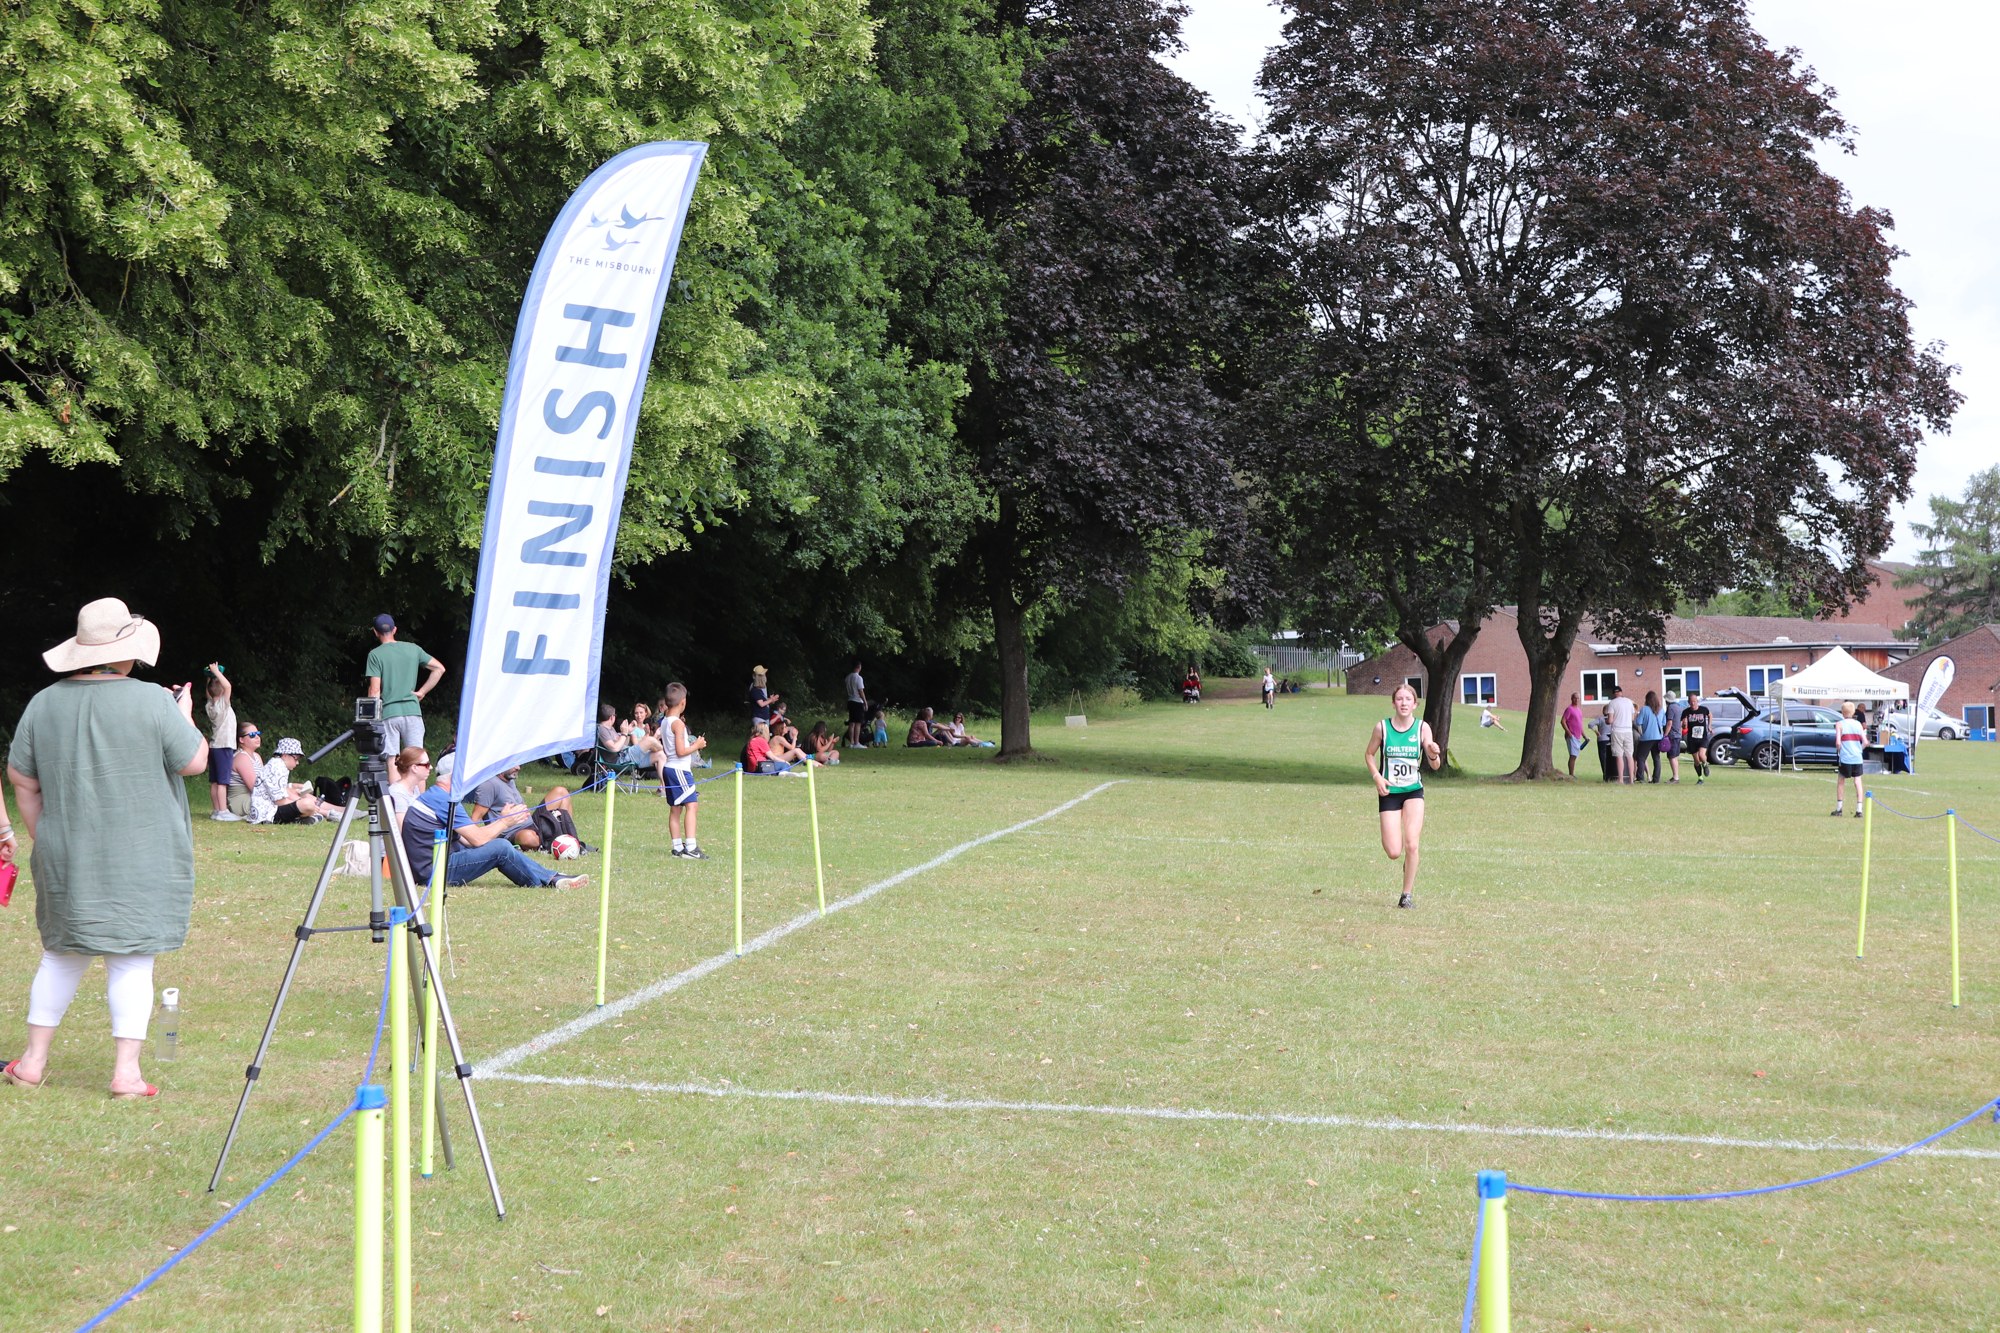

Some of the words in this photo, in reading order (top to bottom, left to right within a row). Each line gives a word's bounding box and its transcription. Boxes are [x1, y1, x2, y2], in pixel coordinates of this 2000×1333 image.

[569, 255, 591, 266] THE
[595, 260, 656, 275] MISBOURNE
[501, 302, 636, 676] FINISH
[1394, 764, 1412, 776] 501
